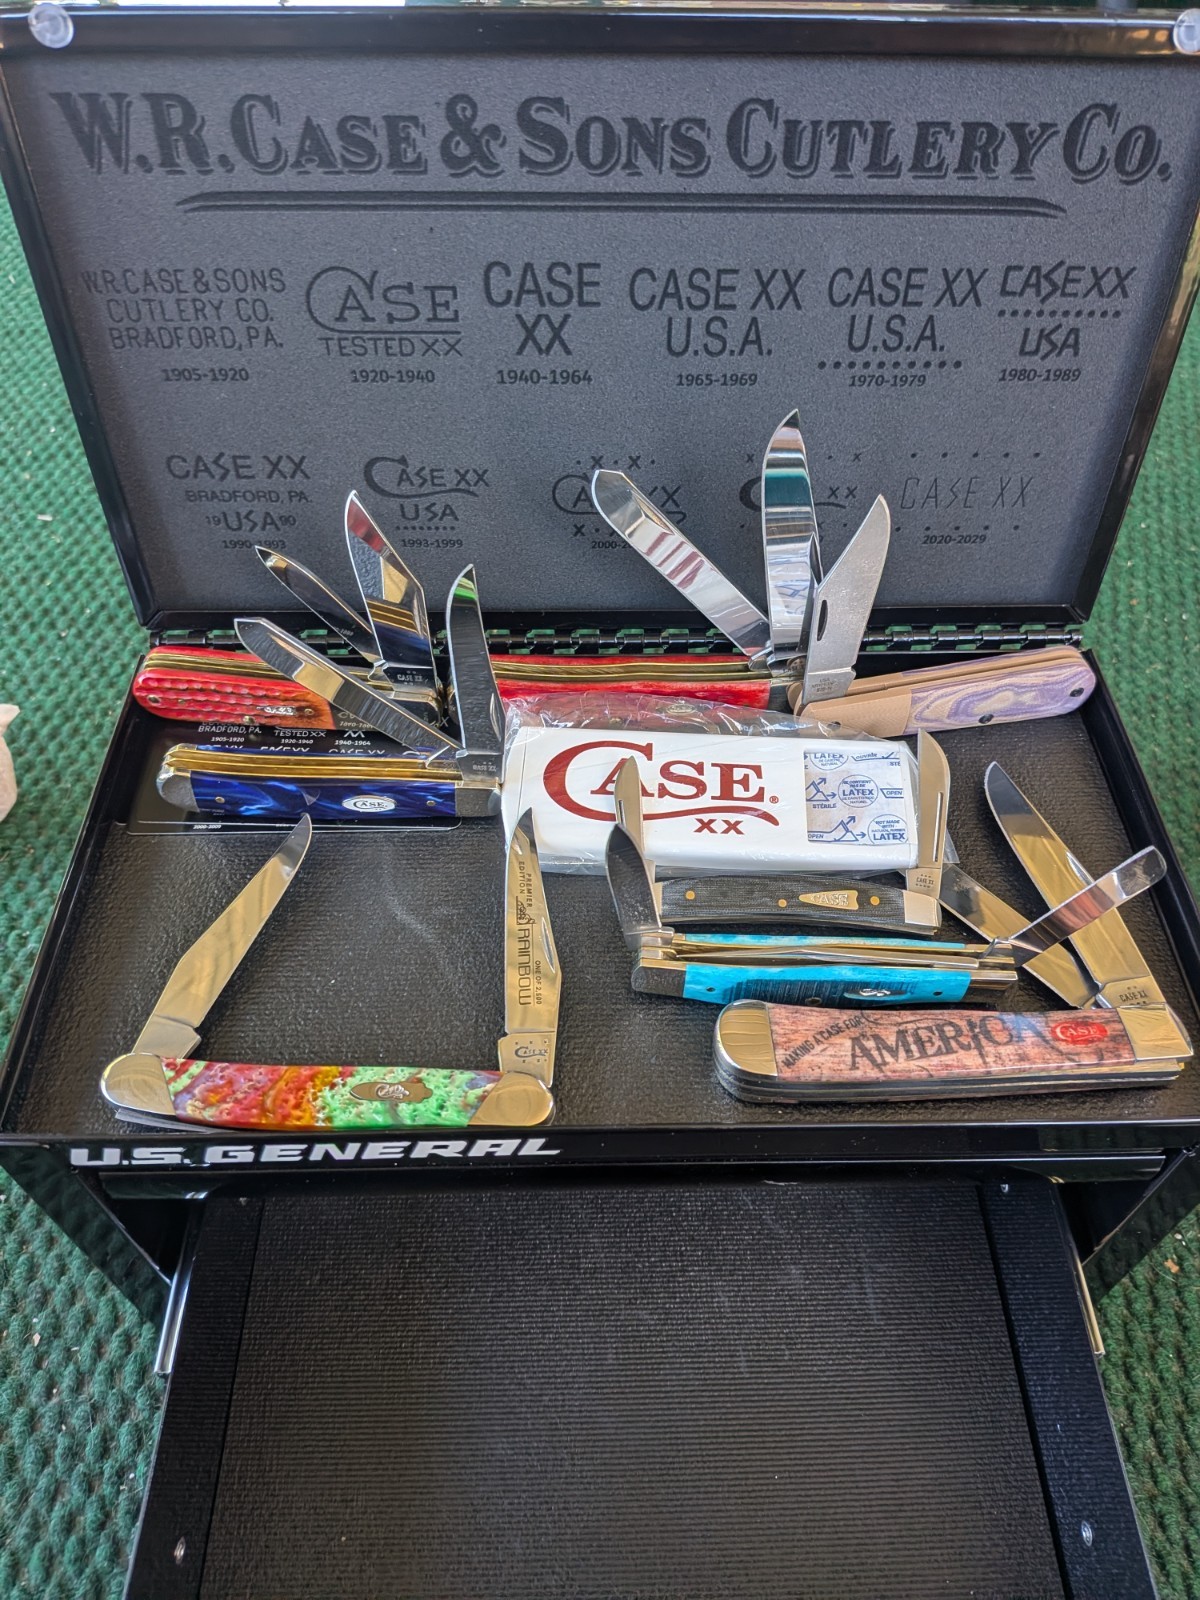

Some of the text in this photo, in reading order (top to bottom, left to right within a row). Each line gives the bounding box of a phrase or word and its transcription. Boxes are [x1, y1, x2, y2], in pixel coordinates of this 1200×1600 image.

[439, 93, 507, 178] &
[516, 96, 712, 178] SONS
[725, 97, 1058, 181] CUTLERY
[1062, 102, 1173, 186] CO.
[213, 267, 286, 294] SONS
[483, 260, 602, 308] CASE
[628, 266, 807, 312] CASE XX
[827, 266, 990, 308] CASE XX
[106, 297, 275, 323] CUTLERY CO.
[305, 265, 462, 335] CASE
[108, 325, 285, 351] BRADFORD, PA.
[514, 313, 573, 357] XX
[666, 315, 774, 358] U.S.A.
[847, 313, 946, 354] U.S.A.
[1018, 322, 1081, 362] USA
[317, 336, 463, 358] TESTED XX
[162, 367, 250, 382] 1905-1920
[350, 369, 436, 384] 1920-1940
[496, 369, 594, 385] 1940-1964
[675, 373, 758, 387] 1965-1969
[848, 374, 927, 388] 1970-1979
[998, 368, 1082, 383] 1980-1989
[165, 452, 312, 483] CASE XX
[454, 467, 490, 488] XX
[900, 475, 1034, 510] CASE XX
[400, 502, 460, 522] USA
[401, 538, 464, 549] 1993-1999
[921, 533, 988, 545] 2020-2029
[274, 730, 309, 738] TESTED
[542, 740, 780, 827] CASE
[842, 788, 875, 797] LATEX
[692, 818, 745, 835] XX
[873, 832, 906, 841] LATEX
[518, 861, 526, 895] EDITION
[525, 873, 533, 908] PREMIER
[517, 927, 532, 1006] RAINBOW
[534, 959, 542, 974] ONE
[535, 975, 542, 986] OF
[1055, 1021, 1104, 1041] CASE
[781, 1039, 815, 1068] MAKING
[819, 1022, 846, 1041] CASE
[69, 1137, 562, 1167] U.S. GENERAL
